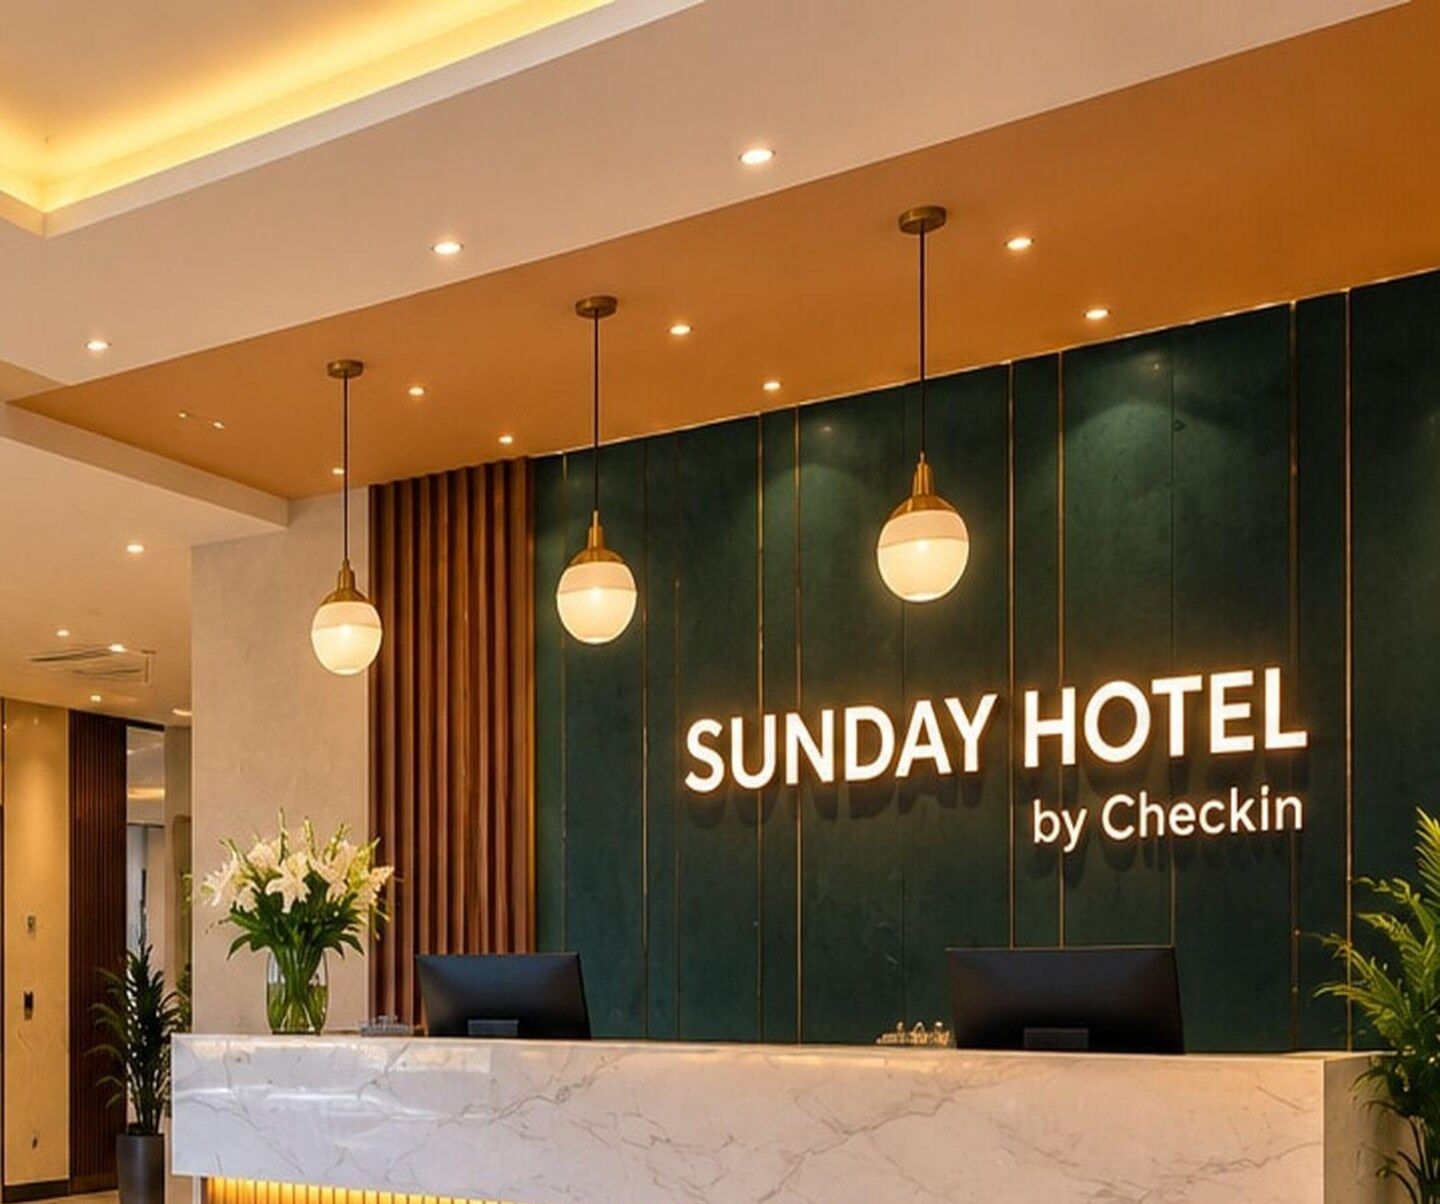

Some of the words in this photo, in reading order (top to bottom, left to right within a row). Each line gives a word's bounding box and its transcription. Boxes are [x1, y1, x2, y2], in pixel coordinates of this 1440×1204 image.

[684, 692, 998, 793] SUNDAY
[1023, 667, 1308, 770] HOTEL
[1033, 799, 1087, 853] by
[1101, 785, 1303, 841] Checkin
